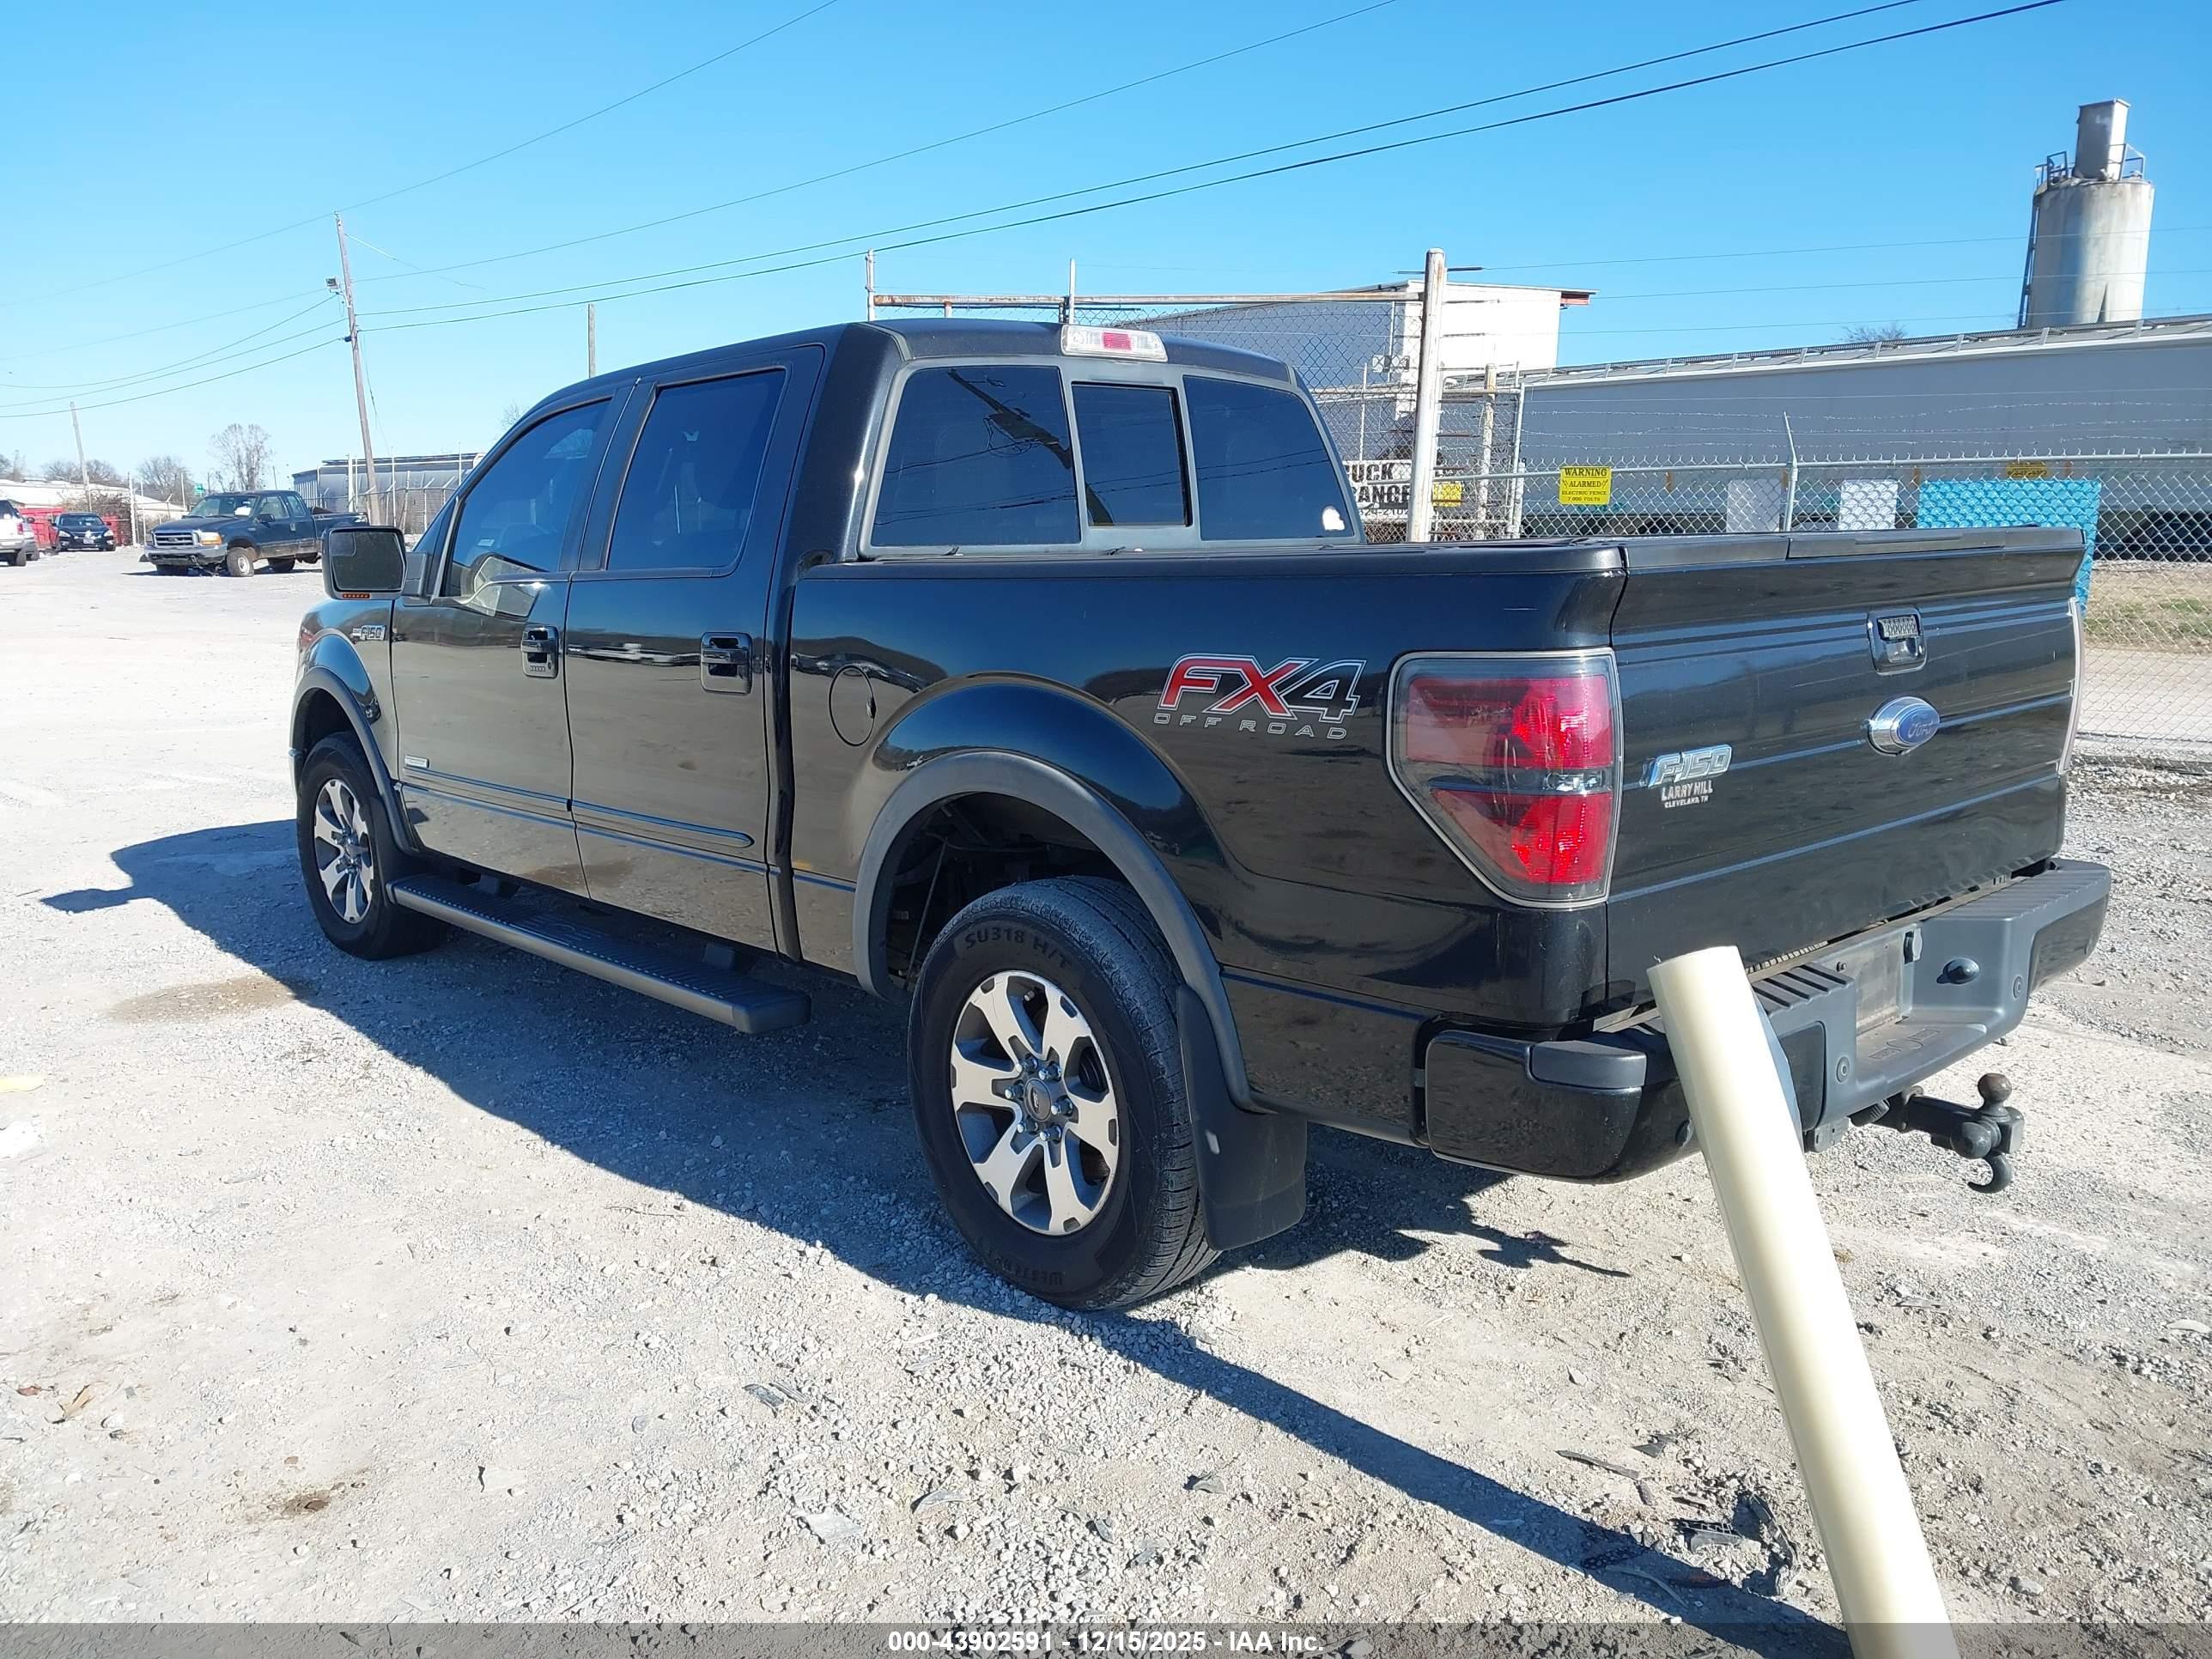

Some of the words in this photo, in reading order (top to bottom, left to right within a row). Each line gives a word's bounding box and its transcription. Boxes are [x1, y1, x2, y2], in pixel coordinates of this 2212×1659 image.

[1565, 468, 1607, 477] WARNING
[1352, 484, 1411, 503] ANCE
[1157, 653, 1368, 724] FX4
[1153, 713, 1223, 729] OFF
[1238, 720, 1347, 740] ROAD
[1907, 720, 1934, 739] Ford
[1661, 783, 1692, 802] LARRY
[1693, 780, 1714, 795] HILL
[963, 927, 1024, 949] SU318
[1032, 936, 1073, 969] H/T
